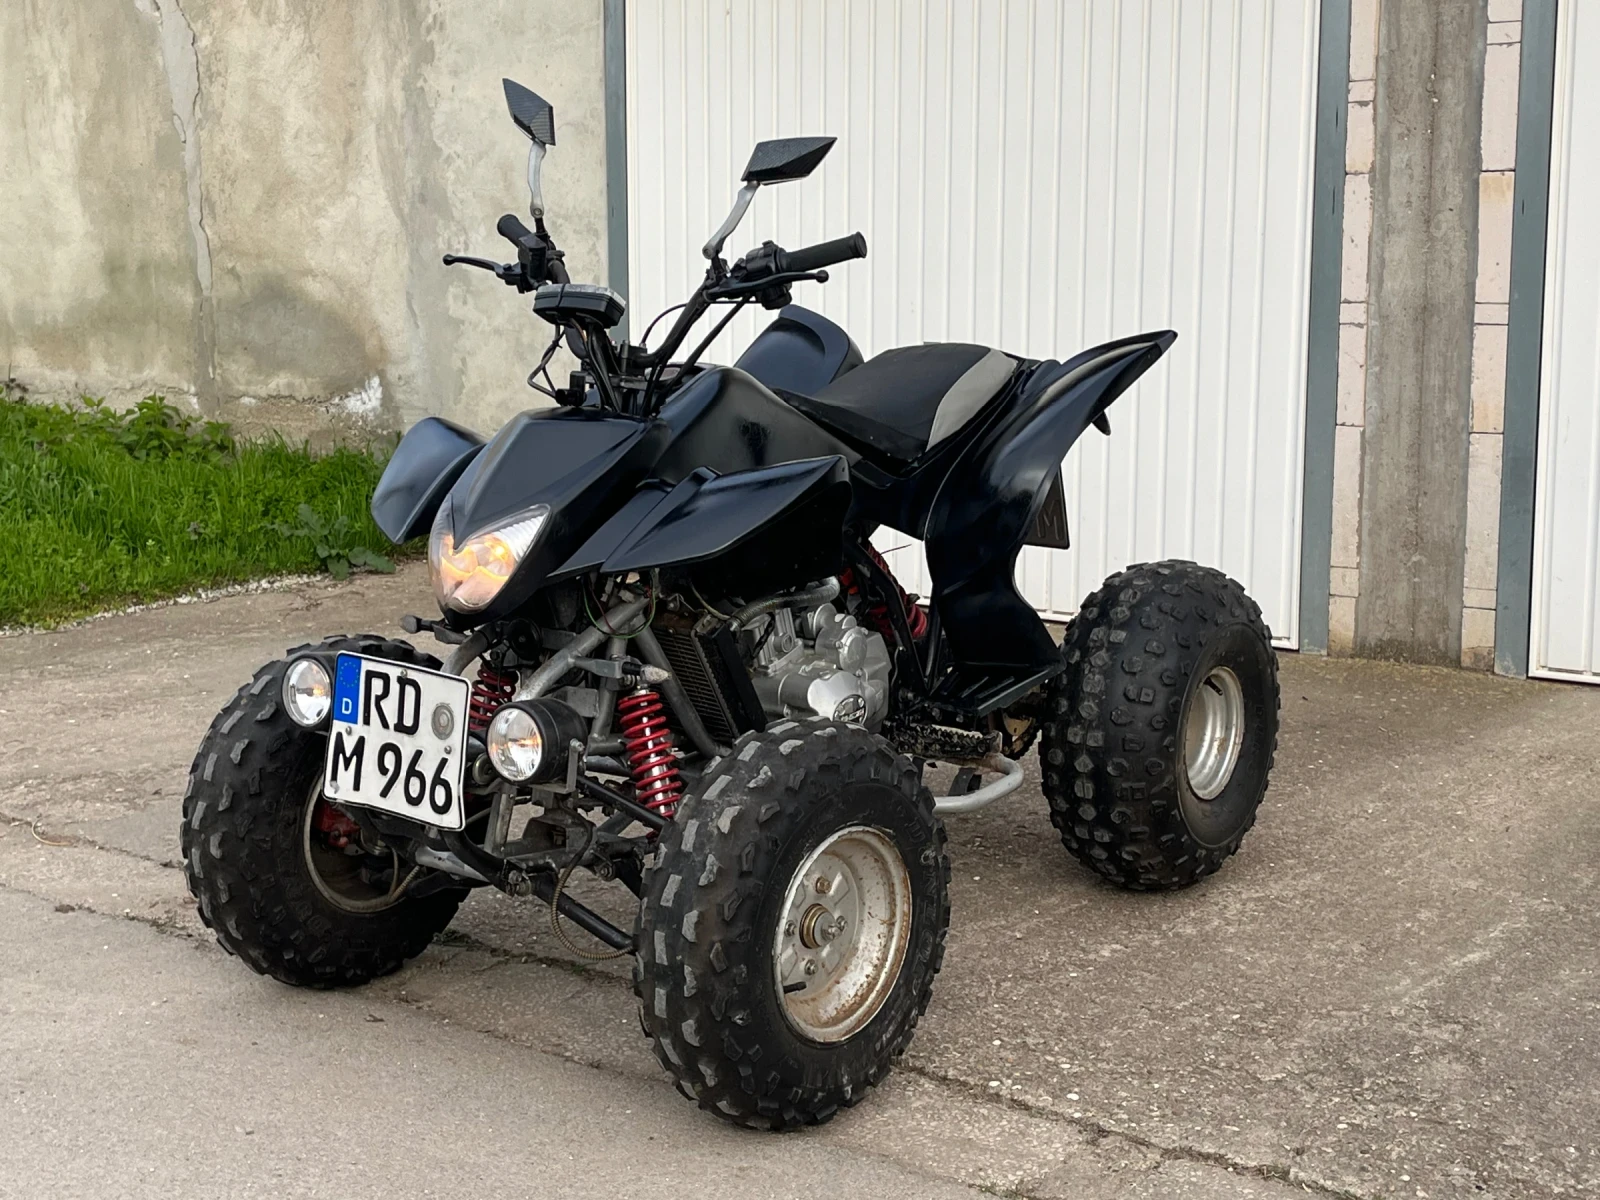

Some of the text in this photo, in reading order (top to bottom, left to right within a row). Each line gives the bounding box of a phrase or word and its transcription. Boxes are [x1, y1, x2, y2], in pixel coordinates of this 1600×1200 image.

[341, 697, 353, 715] D
[362, 669, 422, 736] RD
[330, 731, 453, 815] M 966
